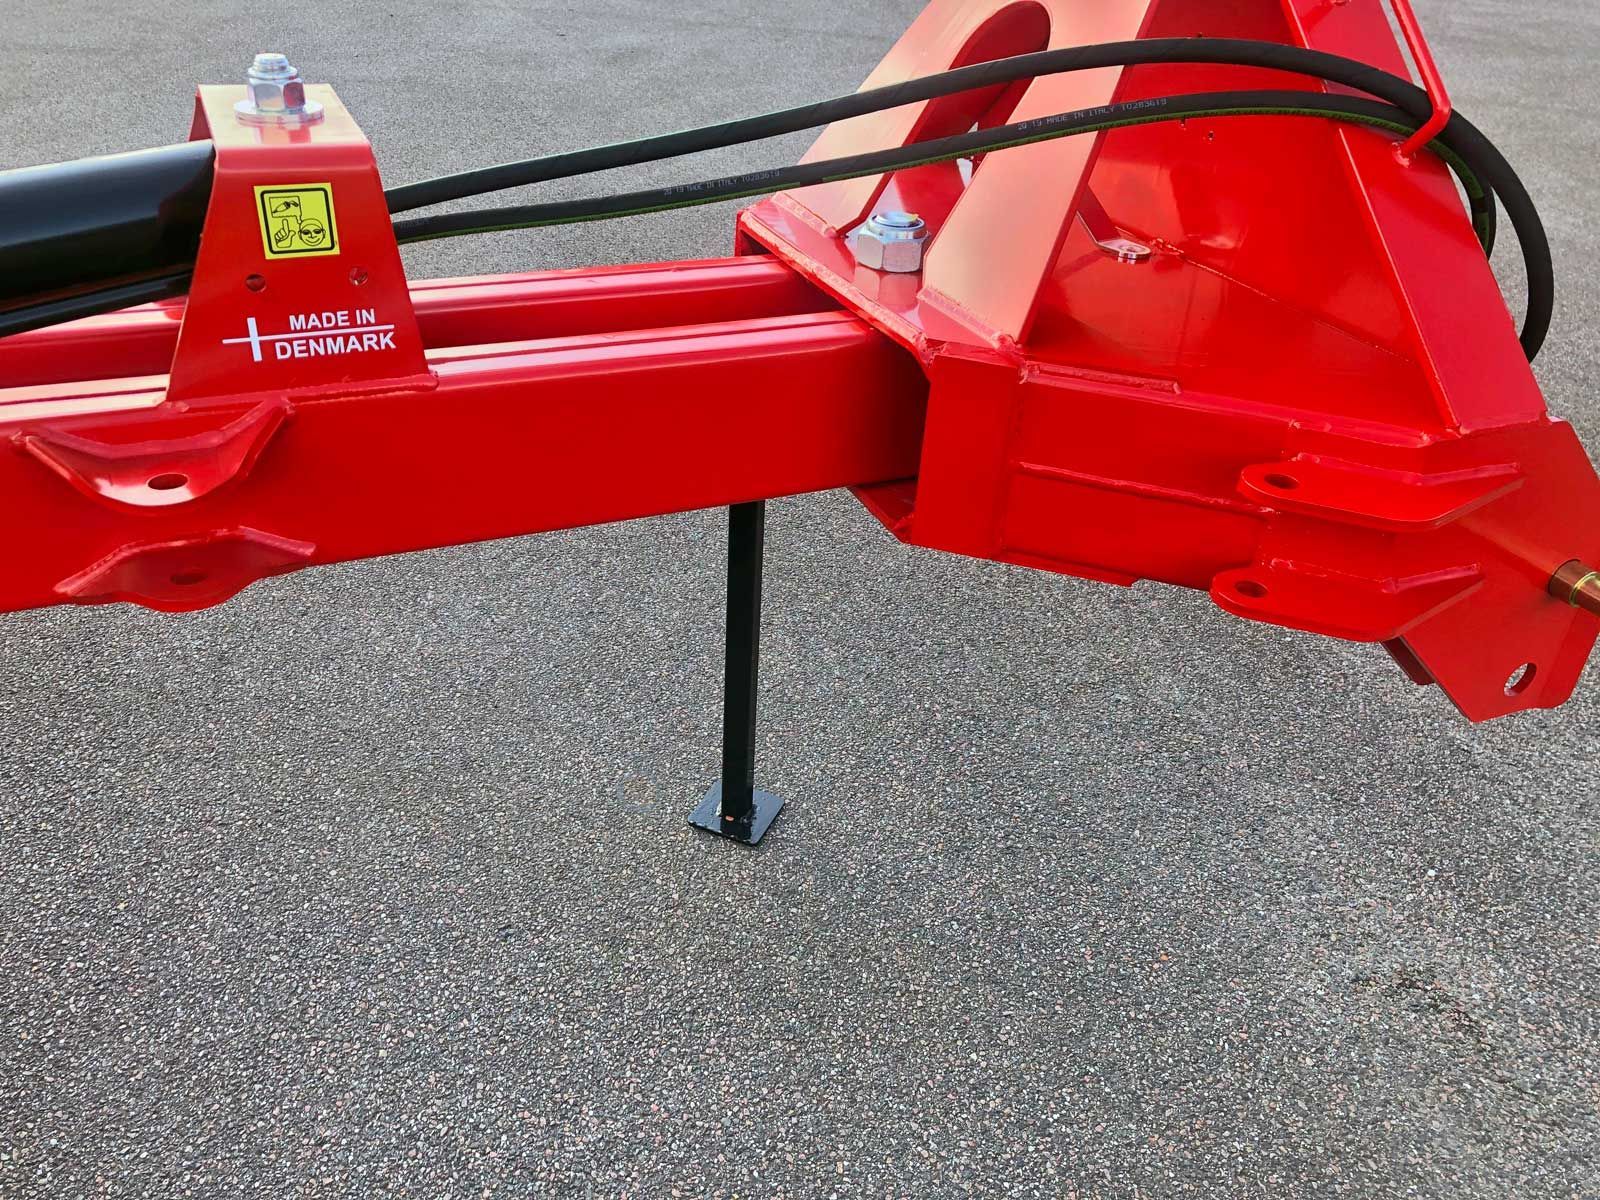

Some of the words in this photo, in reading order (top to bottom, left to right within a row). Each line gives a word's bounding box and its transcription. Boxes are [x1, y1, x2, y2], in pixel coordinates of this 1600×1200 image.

[1046, 115, 1068, 125] MADE
[1073, 111, 1085, 121] IN
[1089, 105, 1115, 117] ITALY
[289, 310, 350, 330] MADE
[355, 308, 376, 325] IN
[274, 331, 397, 360] DENMARK
